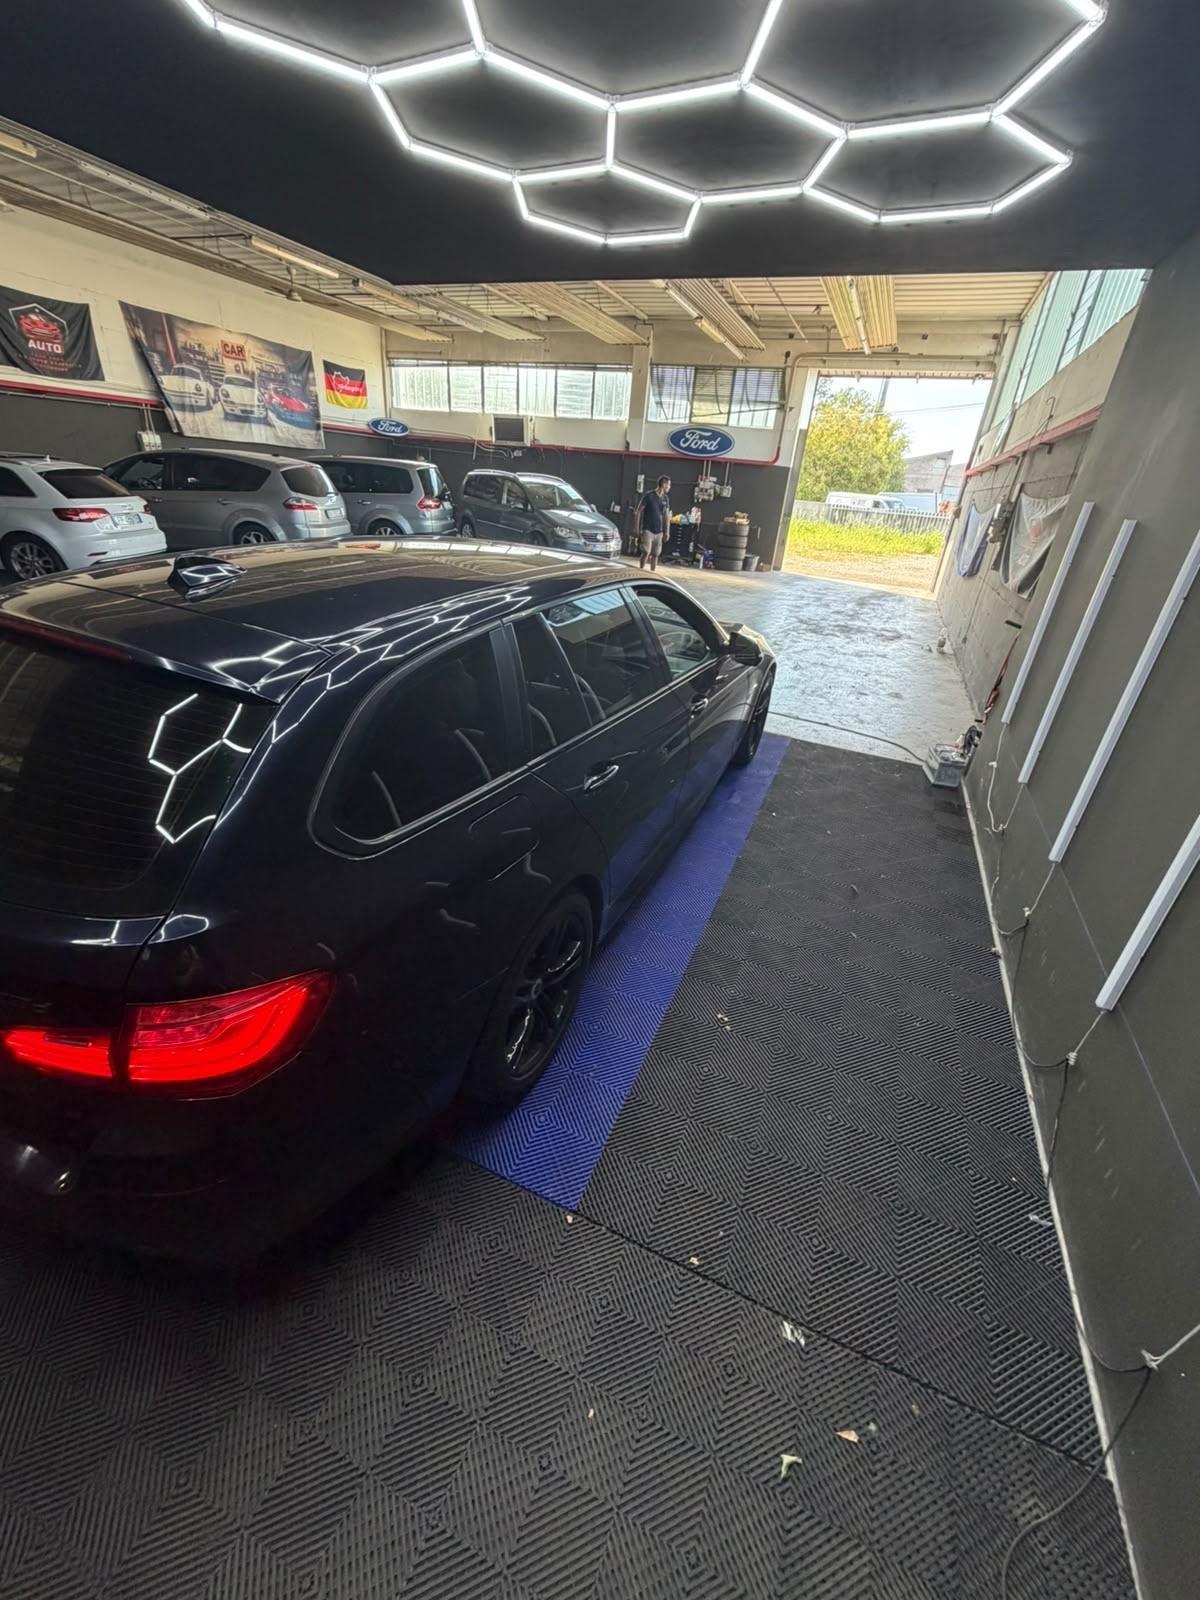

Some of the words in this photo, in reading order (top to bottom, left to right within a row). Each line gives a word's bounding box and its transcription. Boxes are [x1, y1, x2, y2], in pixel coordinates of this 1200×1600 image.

[28, 340, 62, 353] AUTO
[224, 343, 245, 357] CAR
[378, 420, 402, 432] Ford
[680, 429, 721, 451] Ford
